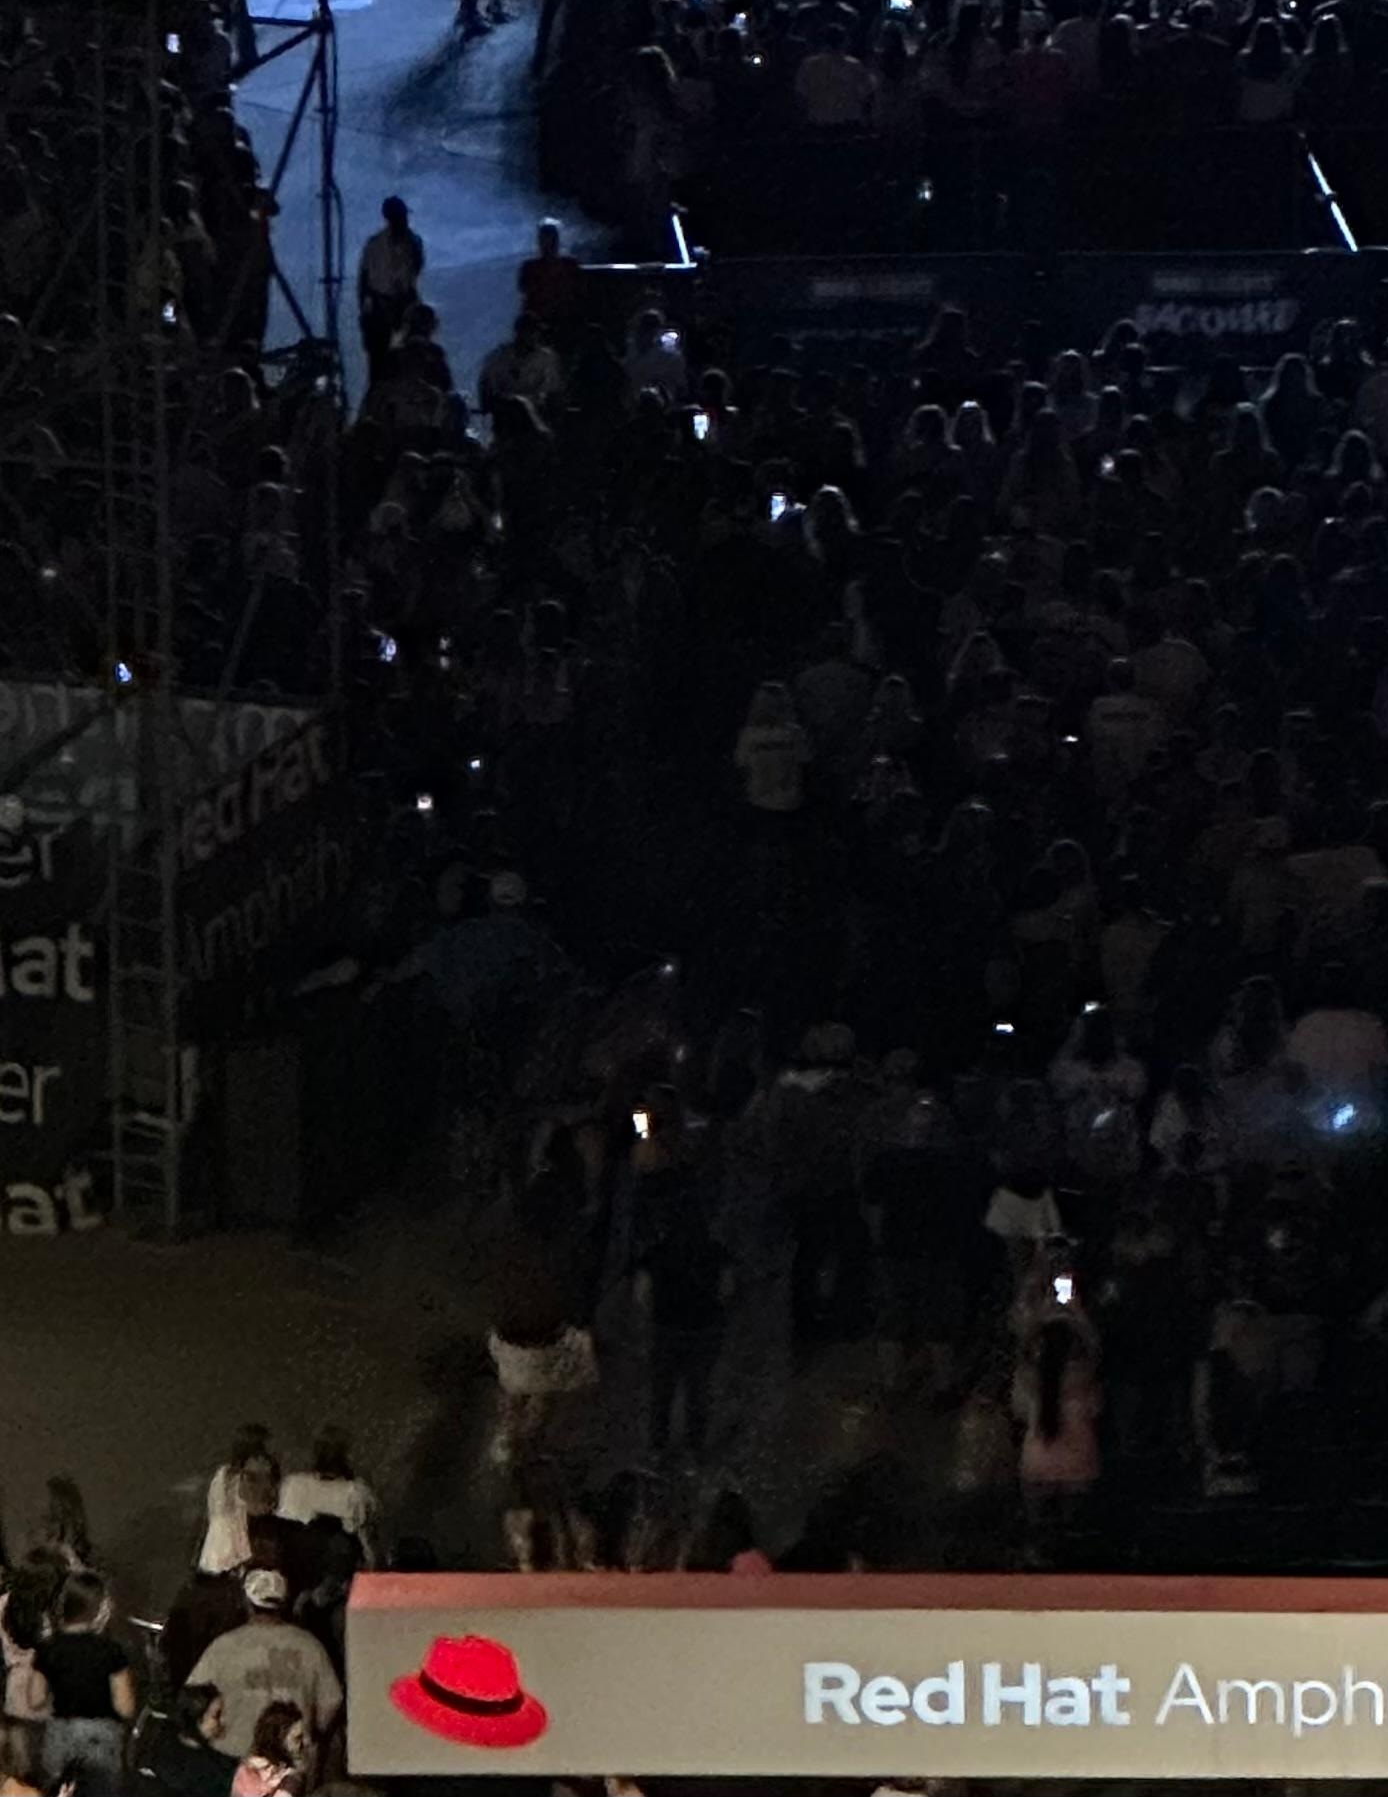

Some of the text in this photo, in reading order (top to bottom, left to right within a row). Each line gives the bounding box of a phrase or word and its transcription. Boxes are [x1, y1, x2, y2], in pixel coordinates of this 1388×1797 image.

[0, 921, 95, 1002] at
[802, 1660, 967, 1726] Red
[981, 1661, 1131, 1726] Hat
